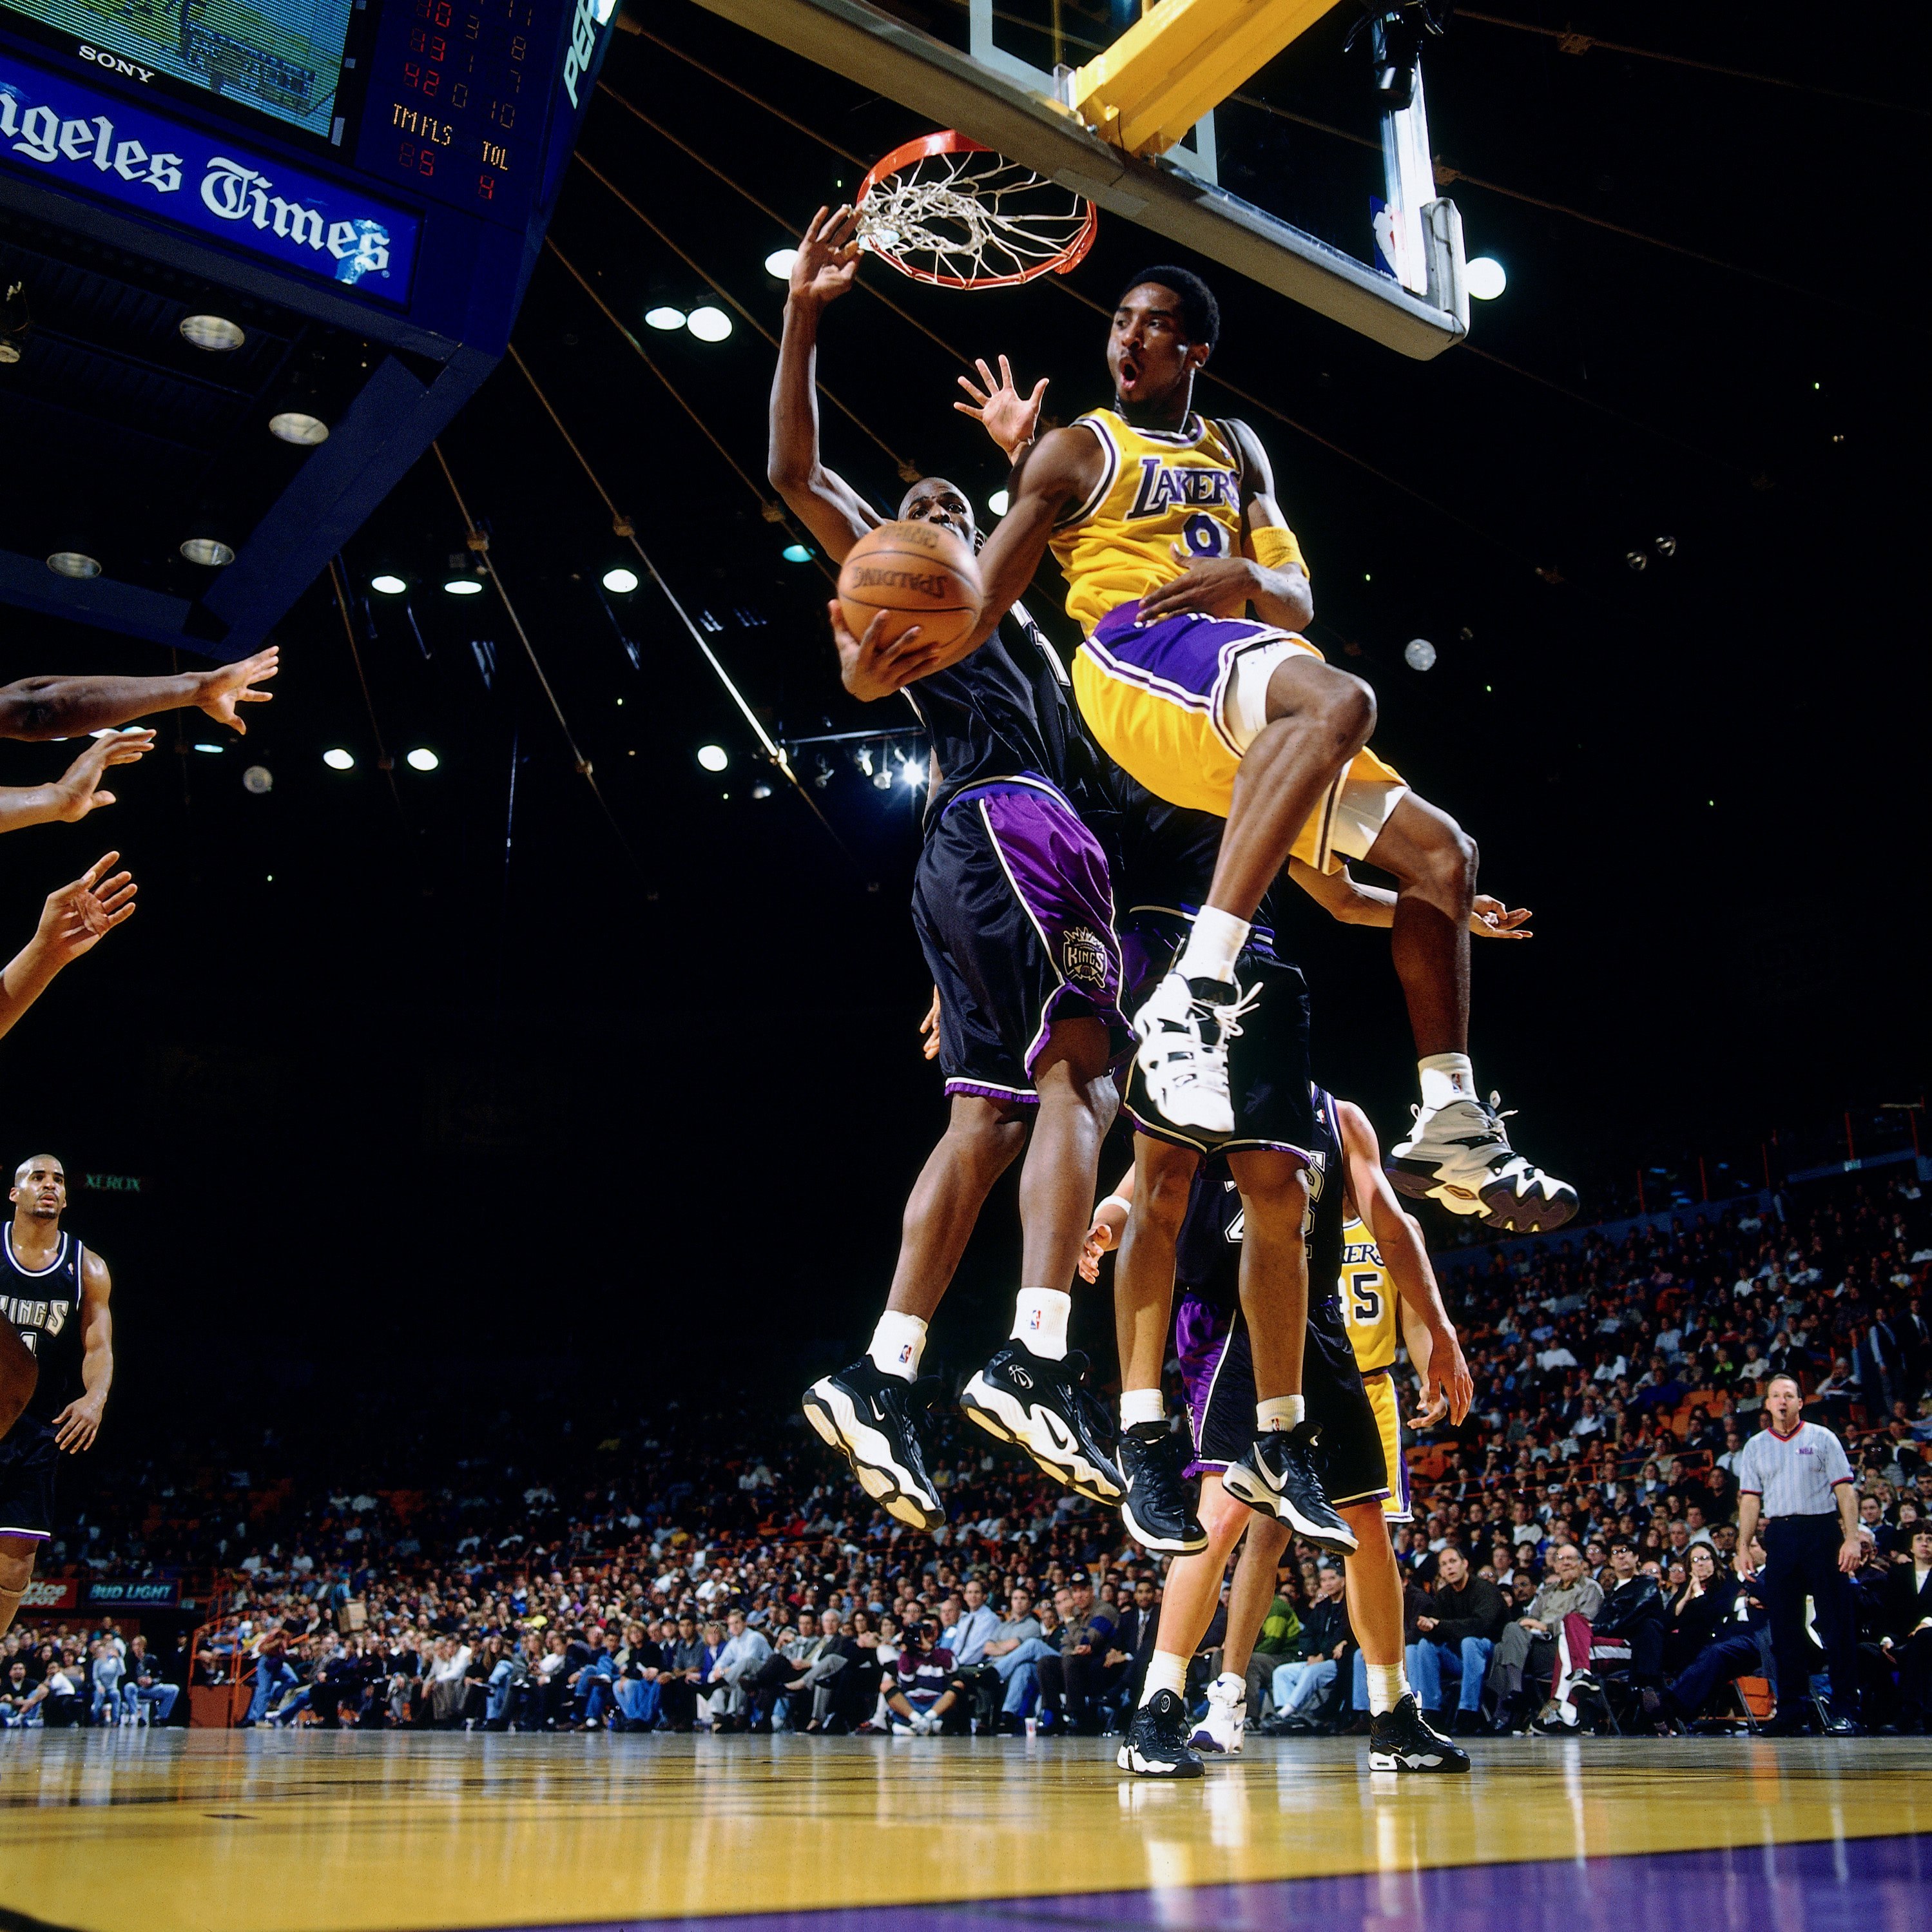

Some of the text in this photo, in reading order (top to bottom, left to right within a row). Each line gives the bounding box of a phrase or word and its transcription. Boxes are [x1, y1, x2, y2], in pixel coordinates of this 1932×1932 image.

[79, 44, 155, 83] SONY
[394, 103, 508, 171] TM FLS TOL
[200, 157, 390, 272] Times
[1068, 946, 1105, 974] KINGS
[85, 1174, 140, 1192] XEROX
[91, 1584, 171, 1599] BUD LIGHT
